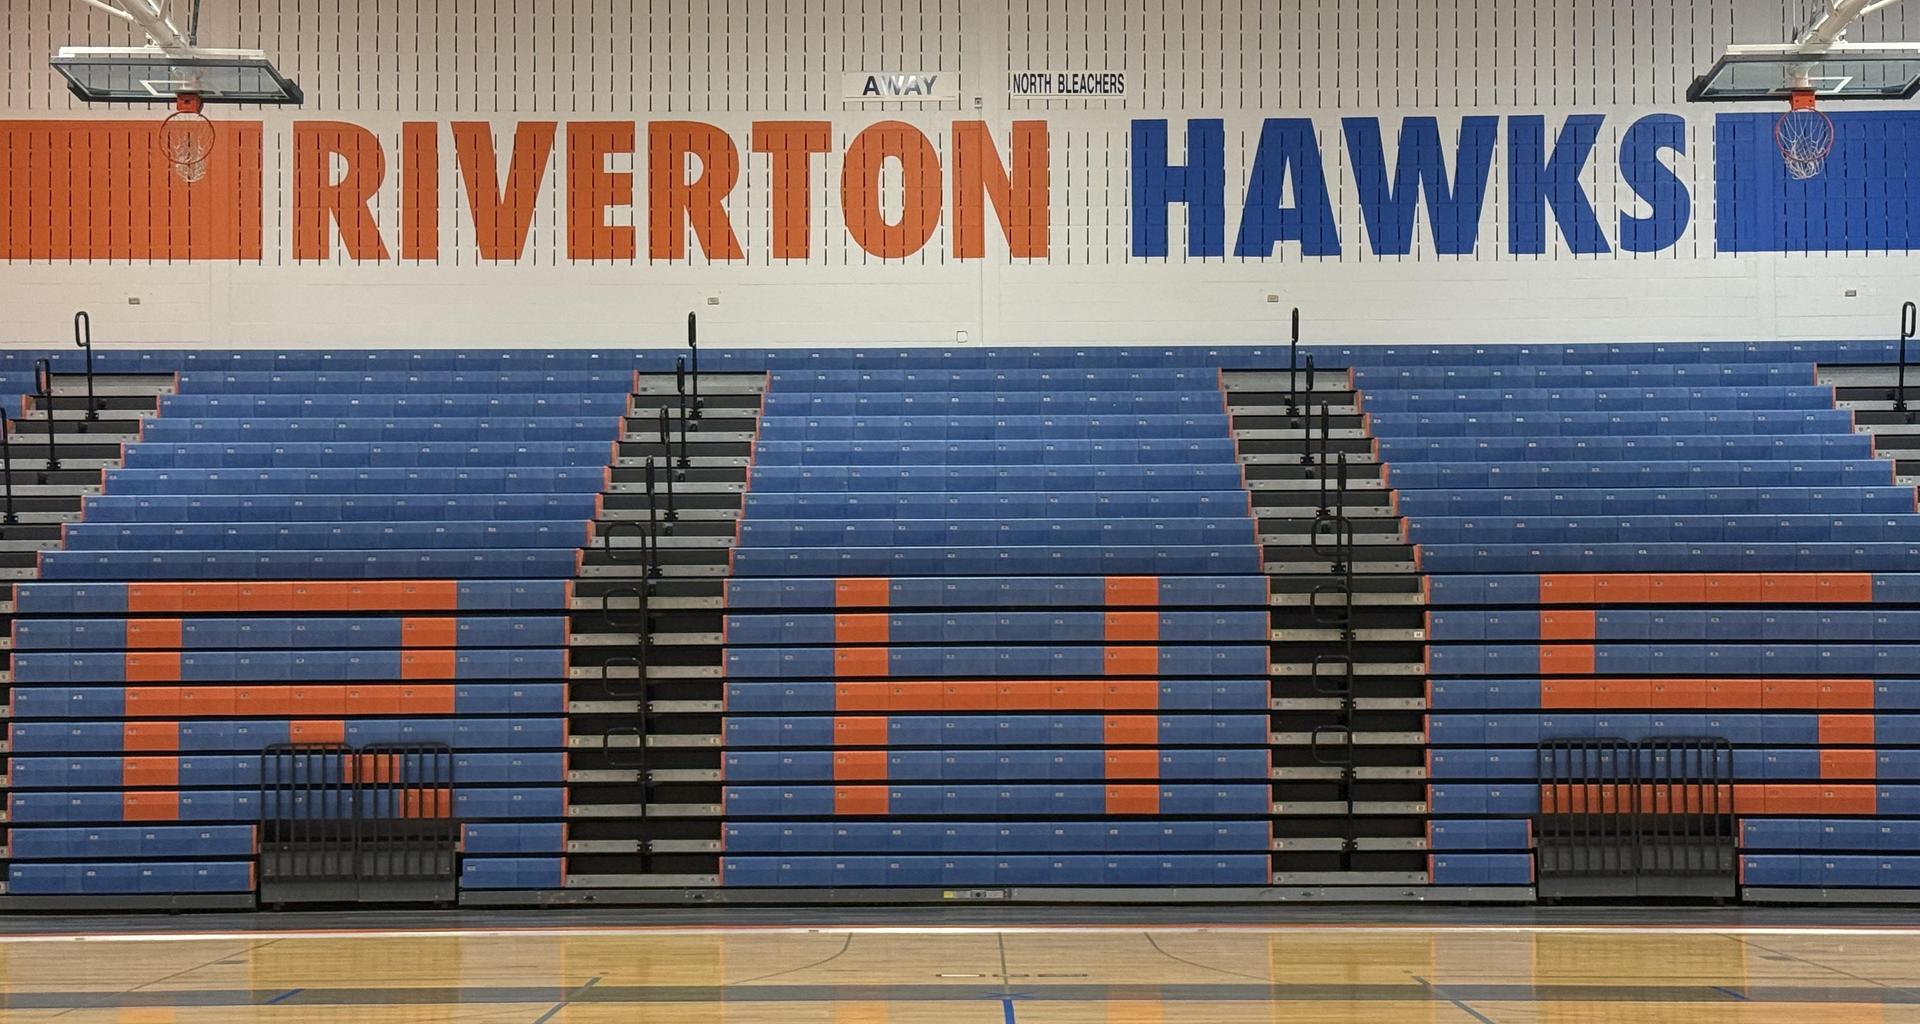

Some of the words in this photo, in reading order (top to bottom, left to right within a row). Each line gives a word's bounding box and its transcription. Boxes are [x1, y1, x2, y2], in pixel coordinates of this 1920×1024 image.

[862, 75, 938, 96] AWAY
[1013, 73, 1052, 94] NORTH
[1058, 73, 1125, 94] BLEACHERS
[293, 119, 1049, 260] RIVERTON
[1131, 113, 1691, 258] HAWKS
